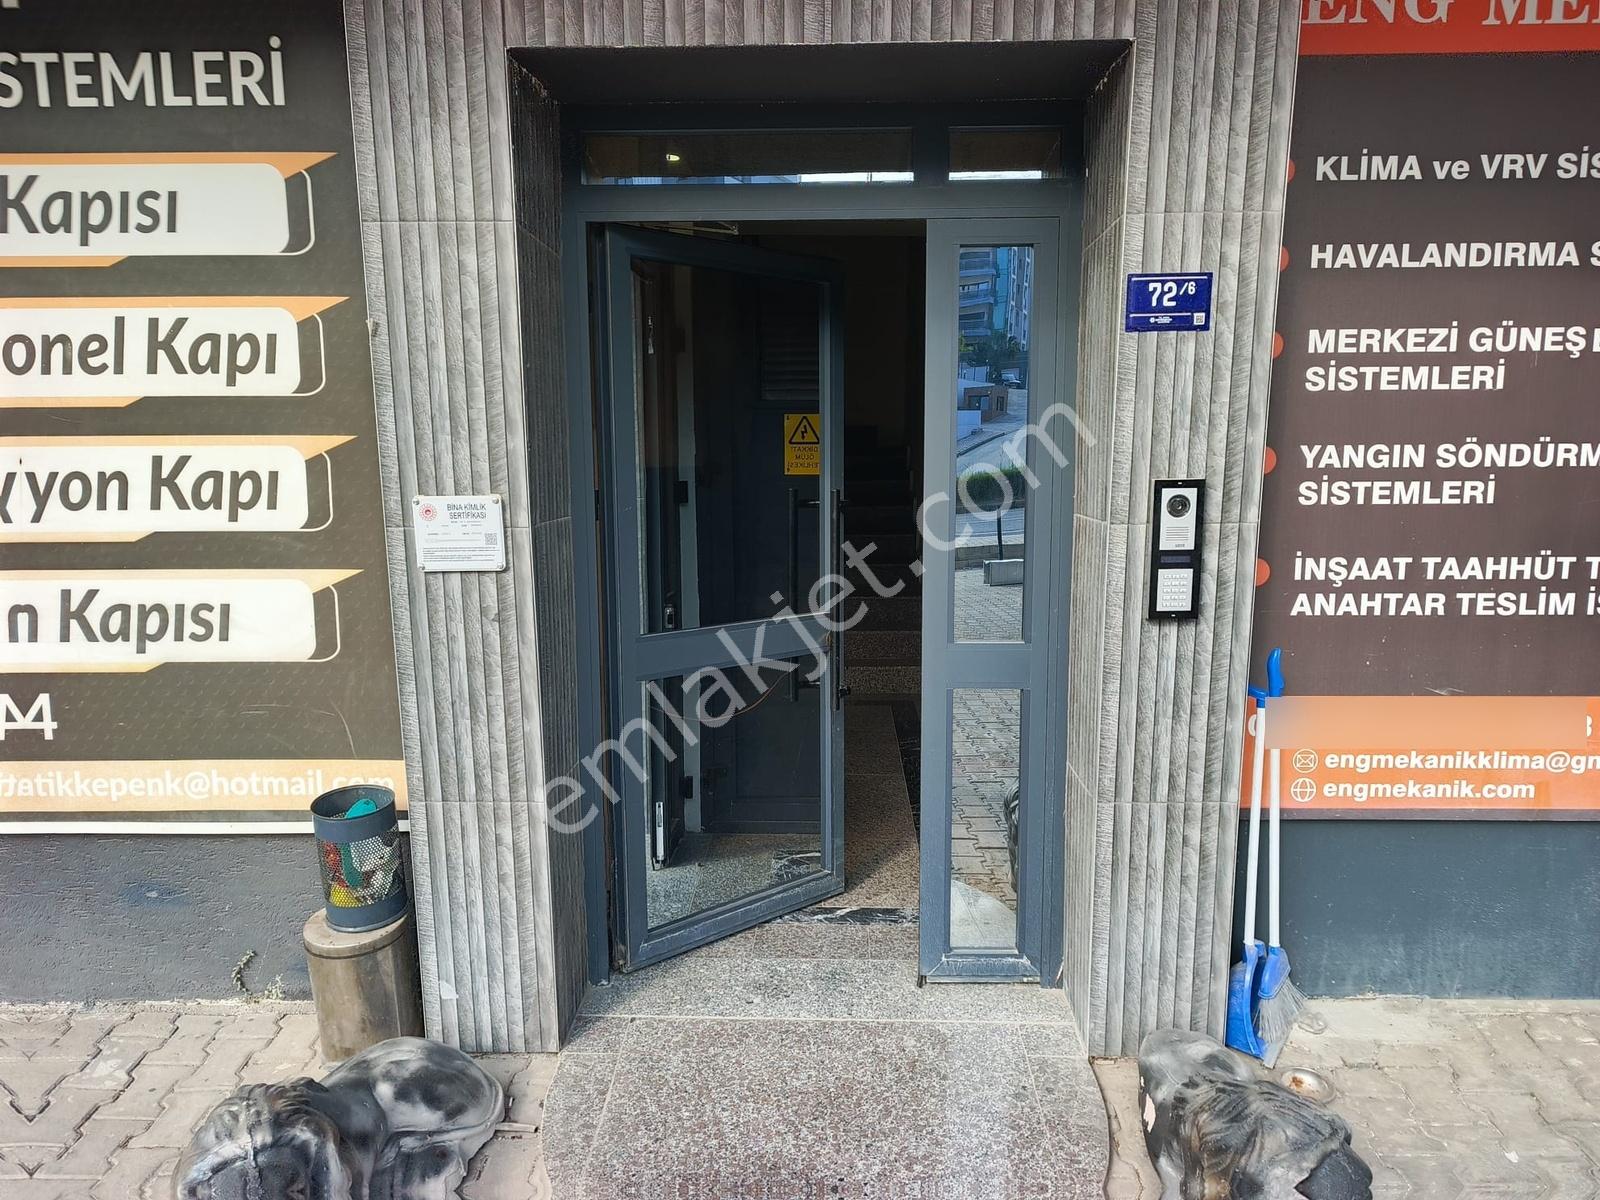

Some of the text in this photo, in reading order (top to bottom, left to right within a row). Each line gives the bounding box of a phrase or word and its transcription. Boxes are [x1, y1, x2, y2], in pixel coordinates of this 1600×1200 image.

[1482, 0, 1600, 26] ME
[1315, 148, 1423, 181] KLİMA
[1432, 159, 1470, 180] ve
[1480, 153, 1548, 179] VRV
[0, 174, 179, 247] Kapısı
[1310, 241, 1580, 269] HAVALANDIRMA
[1148, 281, 1196, 307] 72/6
[2, 316, 278, 387] onel Kapı
[1307, 321, 1459, 354] MERKEZİ
[1469, 320, 1587, 359] GÜNEŞ
[1304, 359, 1506, 392] SİSTEMLERİ
[1300, 436, 1600, 469] YANGIN SÖNDÜRM
[150, 455, 279, 523] Kapı
[1298, 474, 1496, 505] SİSTEMLERİ
[1293, 550, 1413, 587] İNŞAAT
[1421, 549, 1577, 580] TAAHHÜT
[1290, 592, 1446, 617] ANAHTAR
[1456, 586, 1576, 616] TESLİM
[58, 588, 231, 654] Kapısı
[1322, 780, 1536, 802] engmekanik.com
